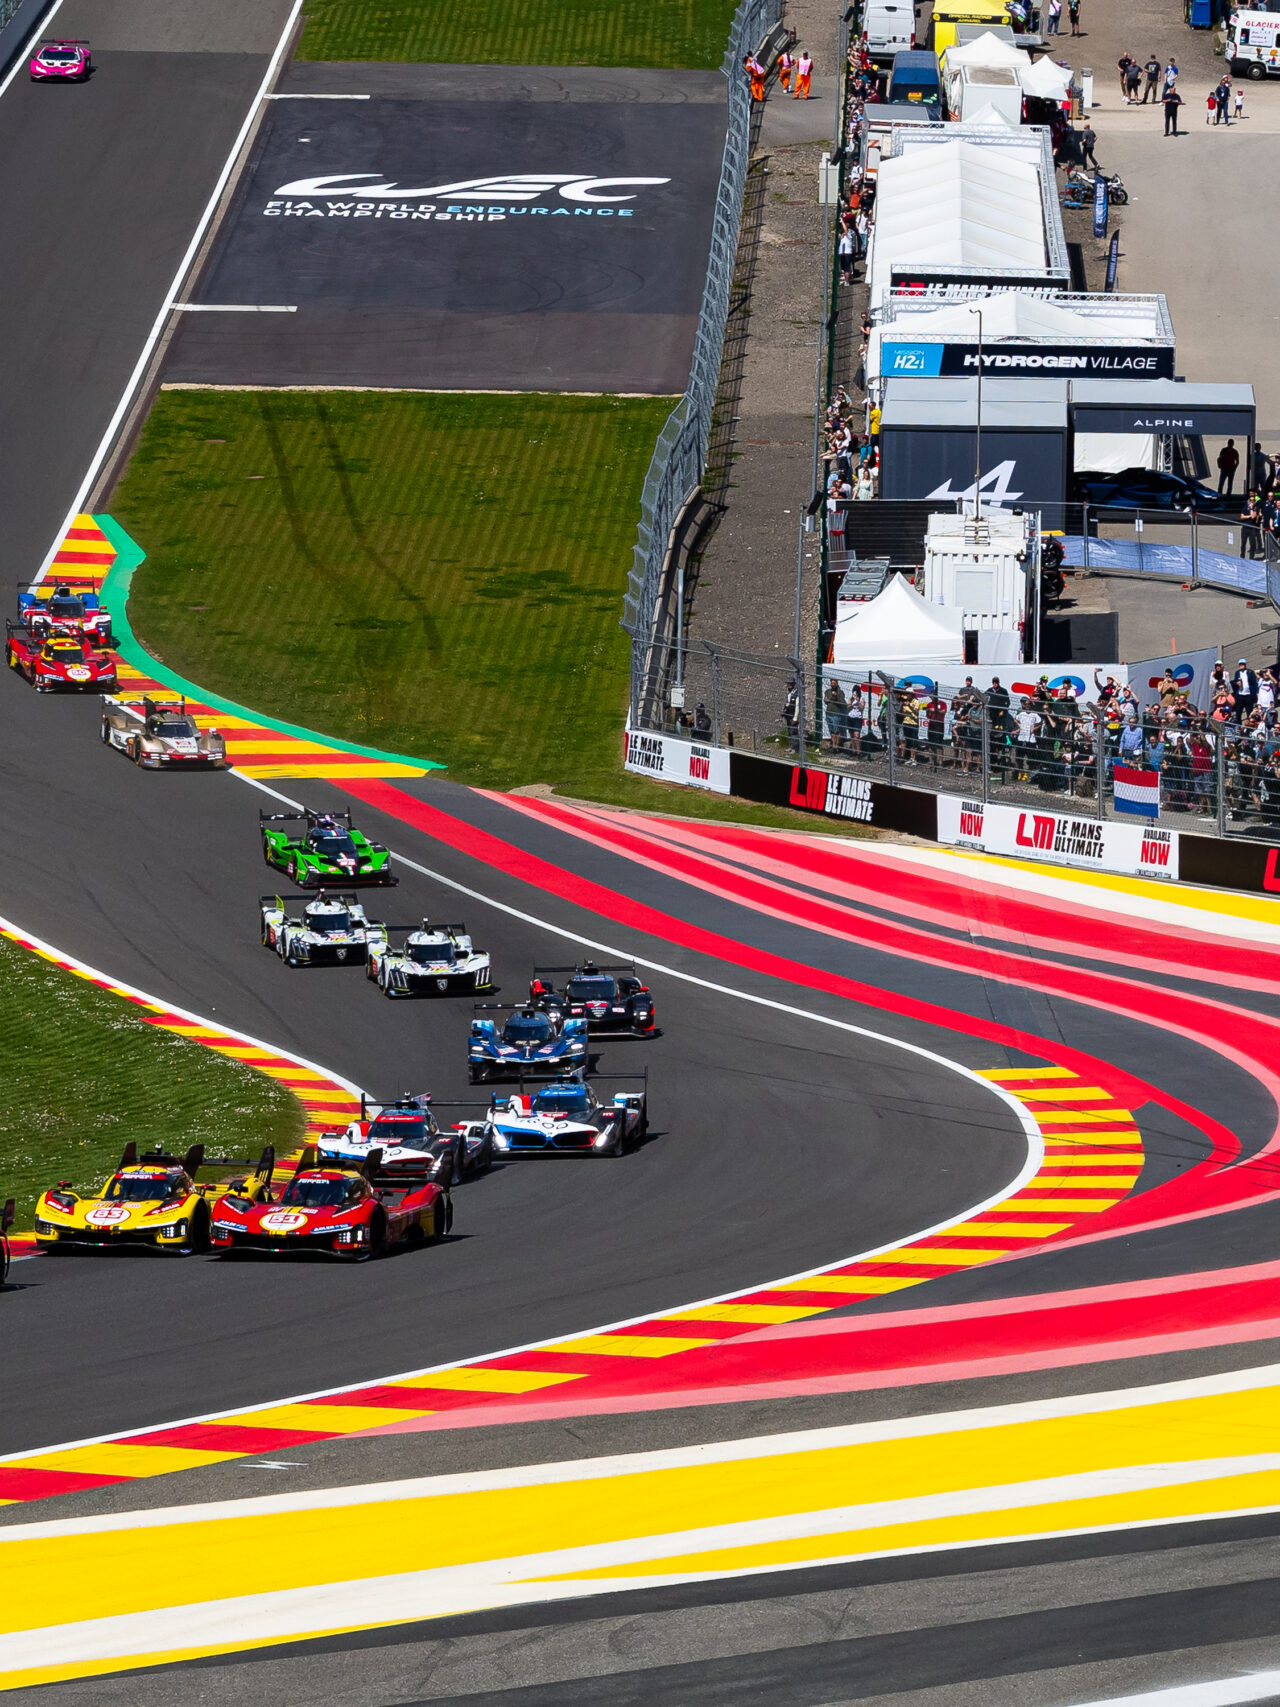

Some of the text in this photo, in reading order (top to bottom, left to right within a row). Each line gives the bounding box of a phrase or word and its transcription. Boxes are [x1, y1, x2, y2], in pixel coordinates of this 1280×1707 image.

[273, 173, 672, 202] WEC
[262, 208, 508, 221] CHAMPIONSHIP
[266, 201, 634, 217] FIA WORLD ENDURANCE
[894, 356, 924, 369] H24
[963, 355, 1158, 369] HYDROGEN VILLAGE
[1133, 419, 1194, 427] ALPINE
[630, 734, 663, 755] LE MANS
[628, 749, 664, 771] ULTIMATE
[689, 756, 710, 780] NOW
[827, 774, 871, 801] LE MANS
[824, 793, 874, 821] ULTIMATE
[961, 801, 984, 814] AVAILABLE
[960, 812, 984, 837] NOW
[1056, 819, 1103, 840] LE MANS
[1143, 829, 1171, 842] AVAILABLE
[1054, 835, 1105, 858] ULTIMATE
[1140, 840, 1170, 866] NOW
[95, 1209, 122, 1219] 83
[270, 1214, 296, 1223] 51
